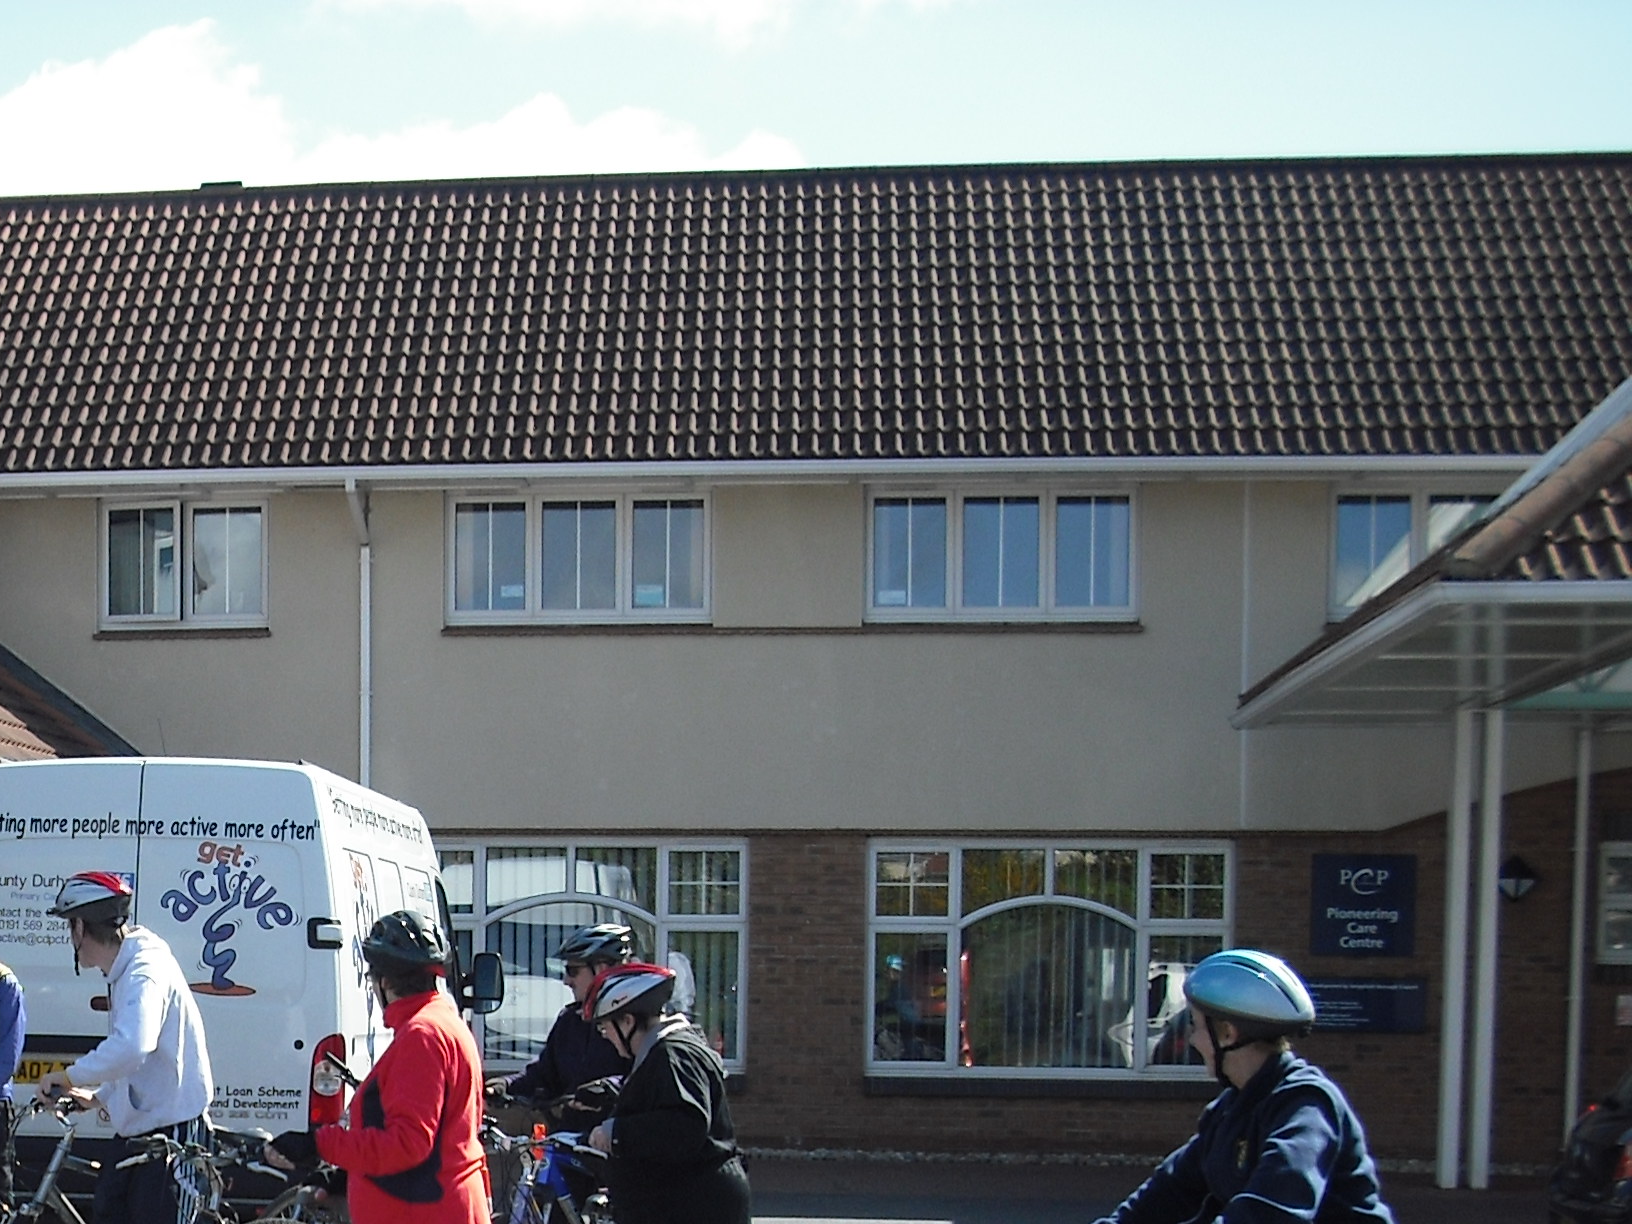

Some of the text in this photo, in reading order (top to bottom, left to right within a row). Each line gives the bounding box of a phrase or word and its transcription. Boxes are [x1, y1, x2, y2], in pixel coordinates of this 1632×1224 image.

[30, 817, 68, 833] more
[72, 812, 121, 839] people
[126, 819, 164, 835] more
[171, 816, 218, 837] active
[224, 821, 265, 838] more
[197, 841, 245, 868] get
[32, 873, 68, 887] Durh
[1340, 868, 1389, 895] PCP
[160, 860, 294, 930] active
[25, 908, 42, 918] the
[1326, 907, 1399, 923] Pioneering
[23, 920, 43, 931] 569
[1346, 922, 1378, 934] Care
[1339, 936, 1385, 948] Centre
[226, 1085, 253, 1096] Loan
[257, 1086, 302, 1097] Scheme
[210, 1098, 300, 1111] and Development
